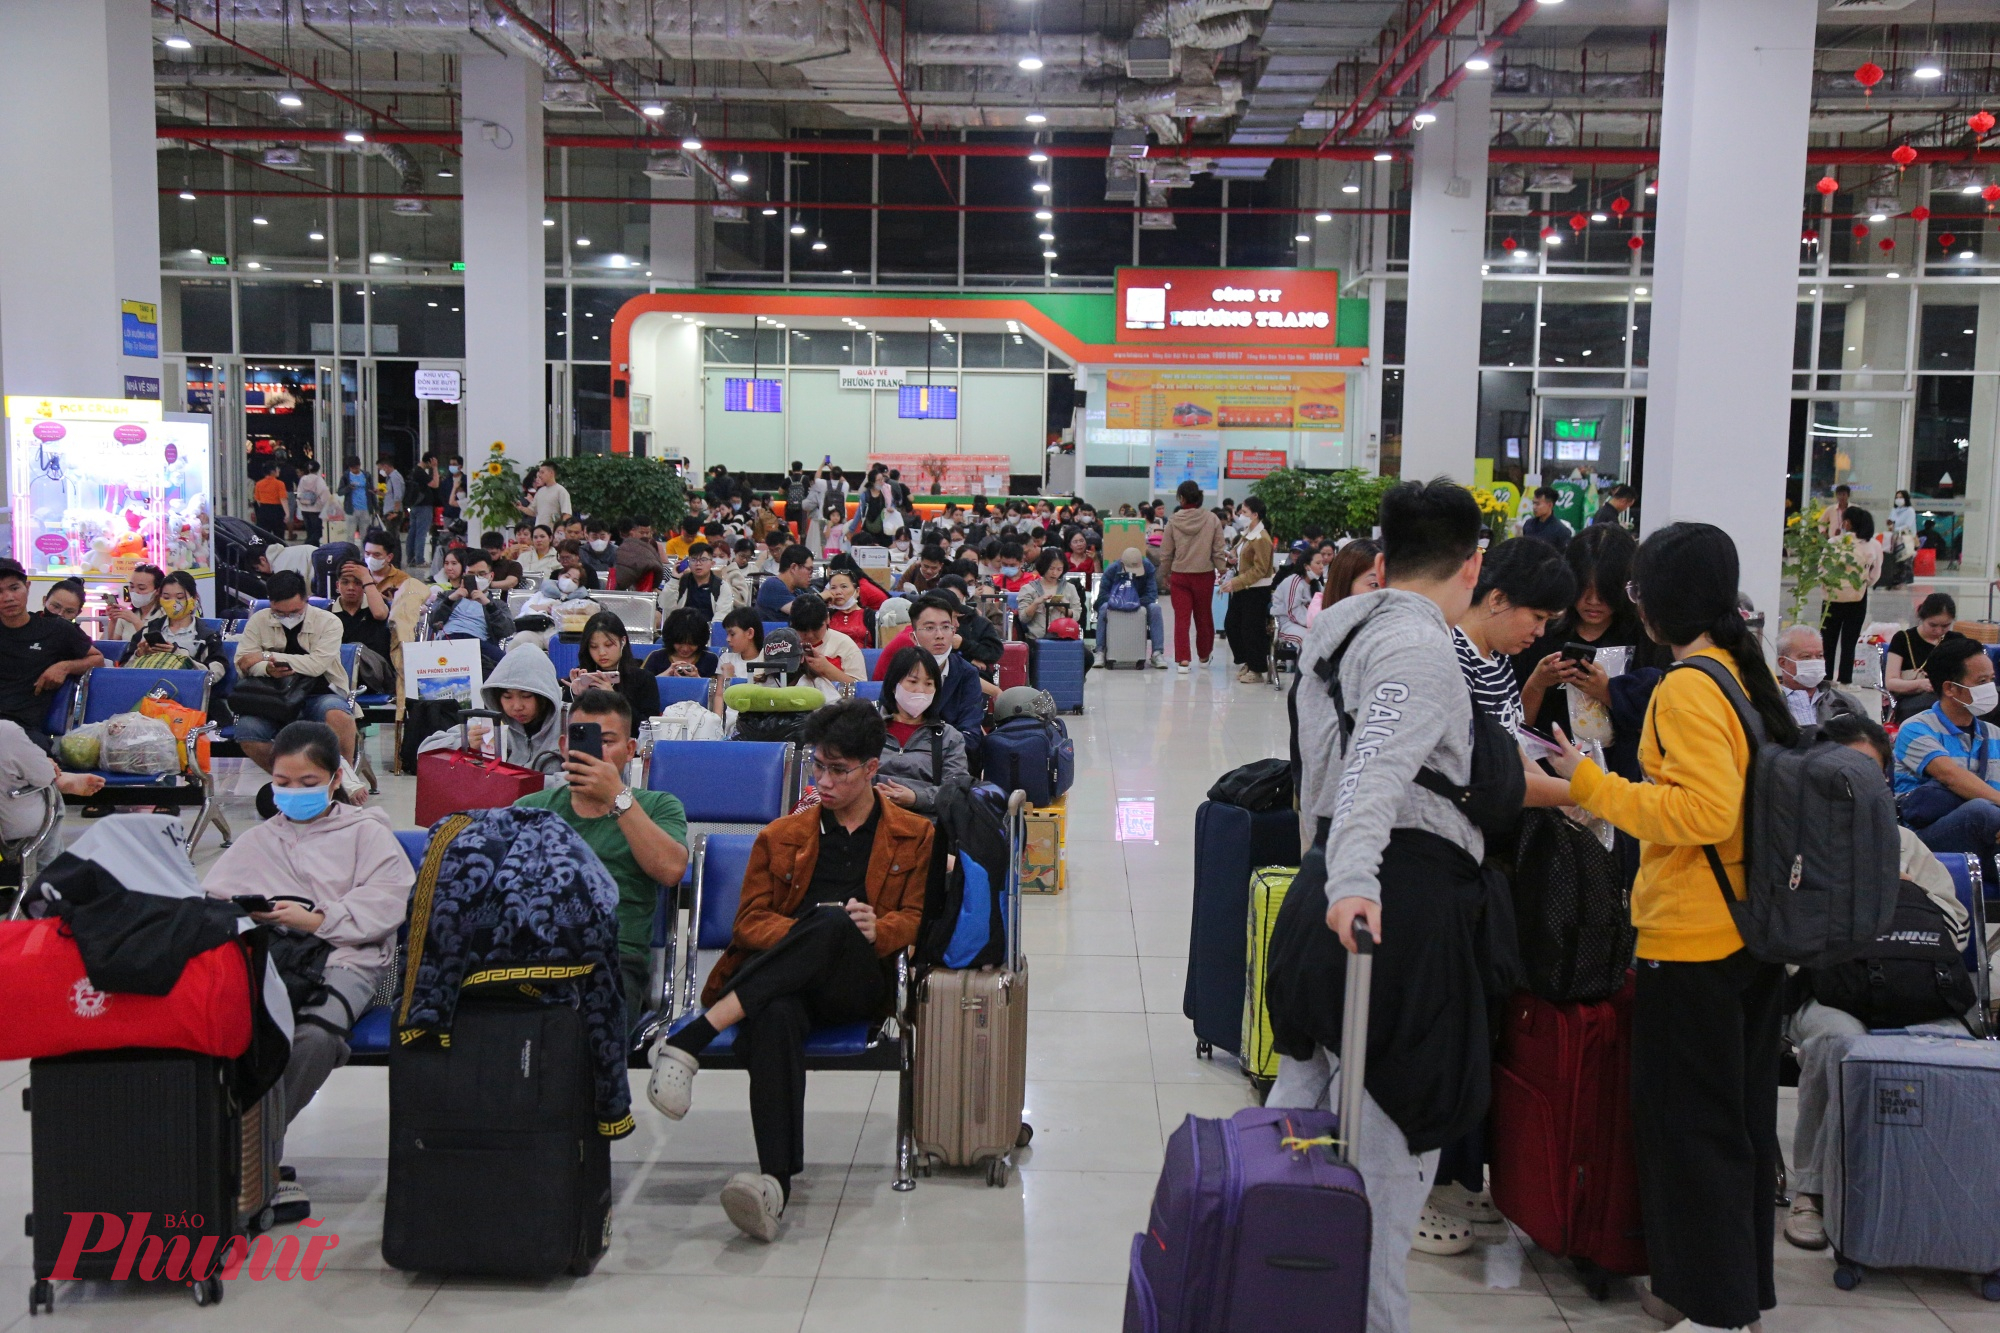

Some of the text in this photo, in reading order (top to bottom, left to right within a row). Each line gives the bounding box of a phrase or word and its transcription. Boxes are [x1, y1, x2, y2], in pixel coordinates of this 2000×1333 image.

[1212, 286, 1282, 302] CÔNG TY
[1170, 308, 1252, 327] PHƯƠNG
[1255, 311, 1330, 328] TRANG
[879, 367, 888, 376] VÉ
[126, 379, 158, 394] NHÀ VỆ SINH
[842, 377, 903, 388] PHƯƠNG TRANG
[1879, 1089, 1900, 1098] THE
[1880, 1098, 1920, 1108] TRAVEL
[1880, 1106, 1907, 1115] STAR
